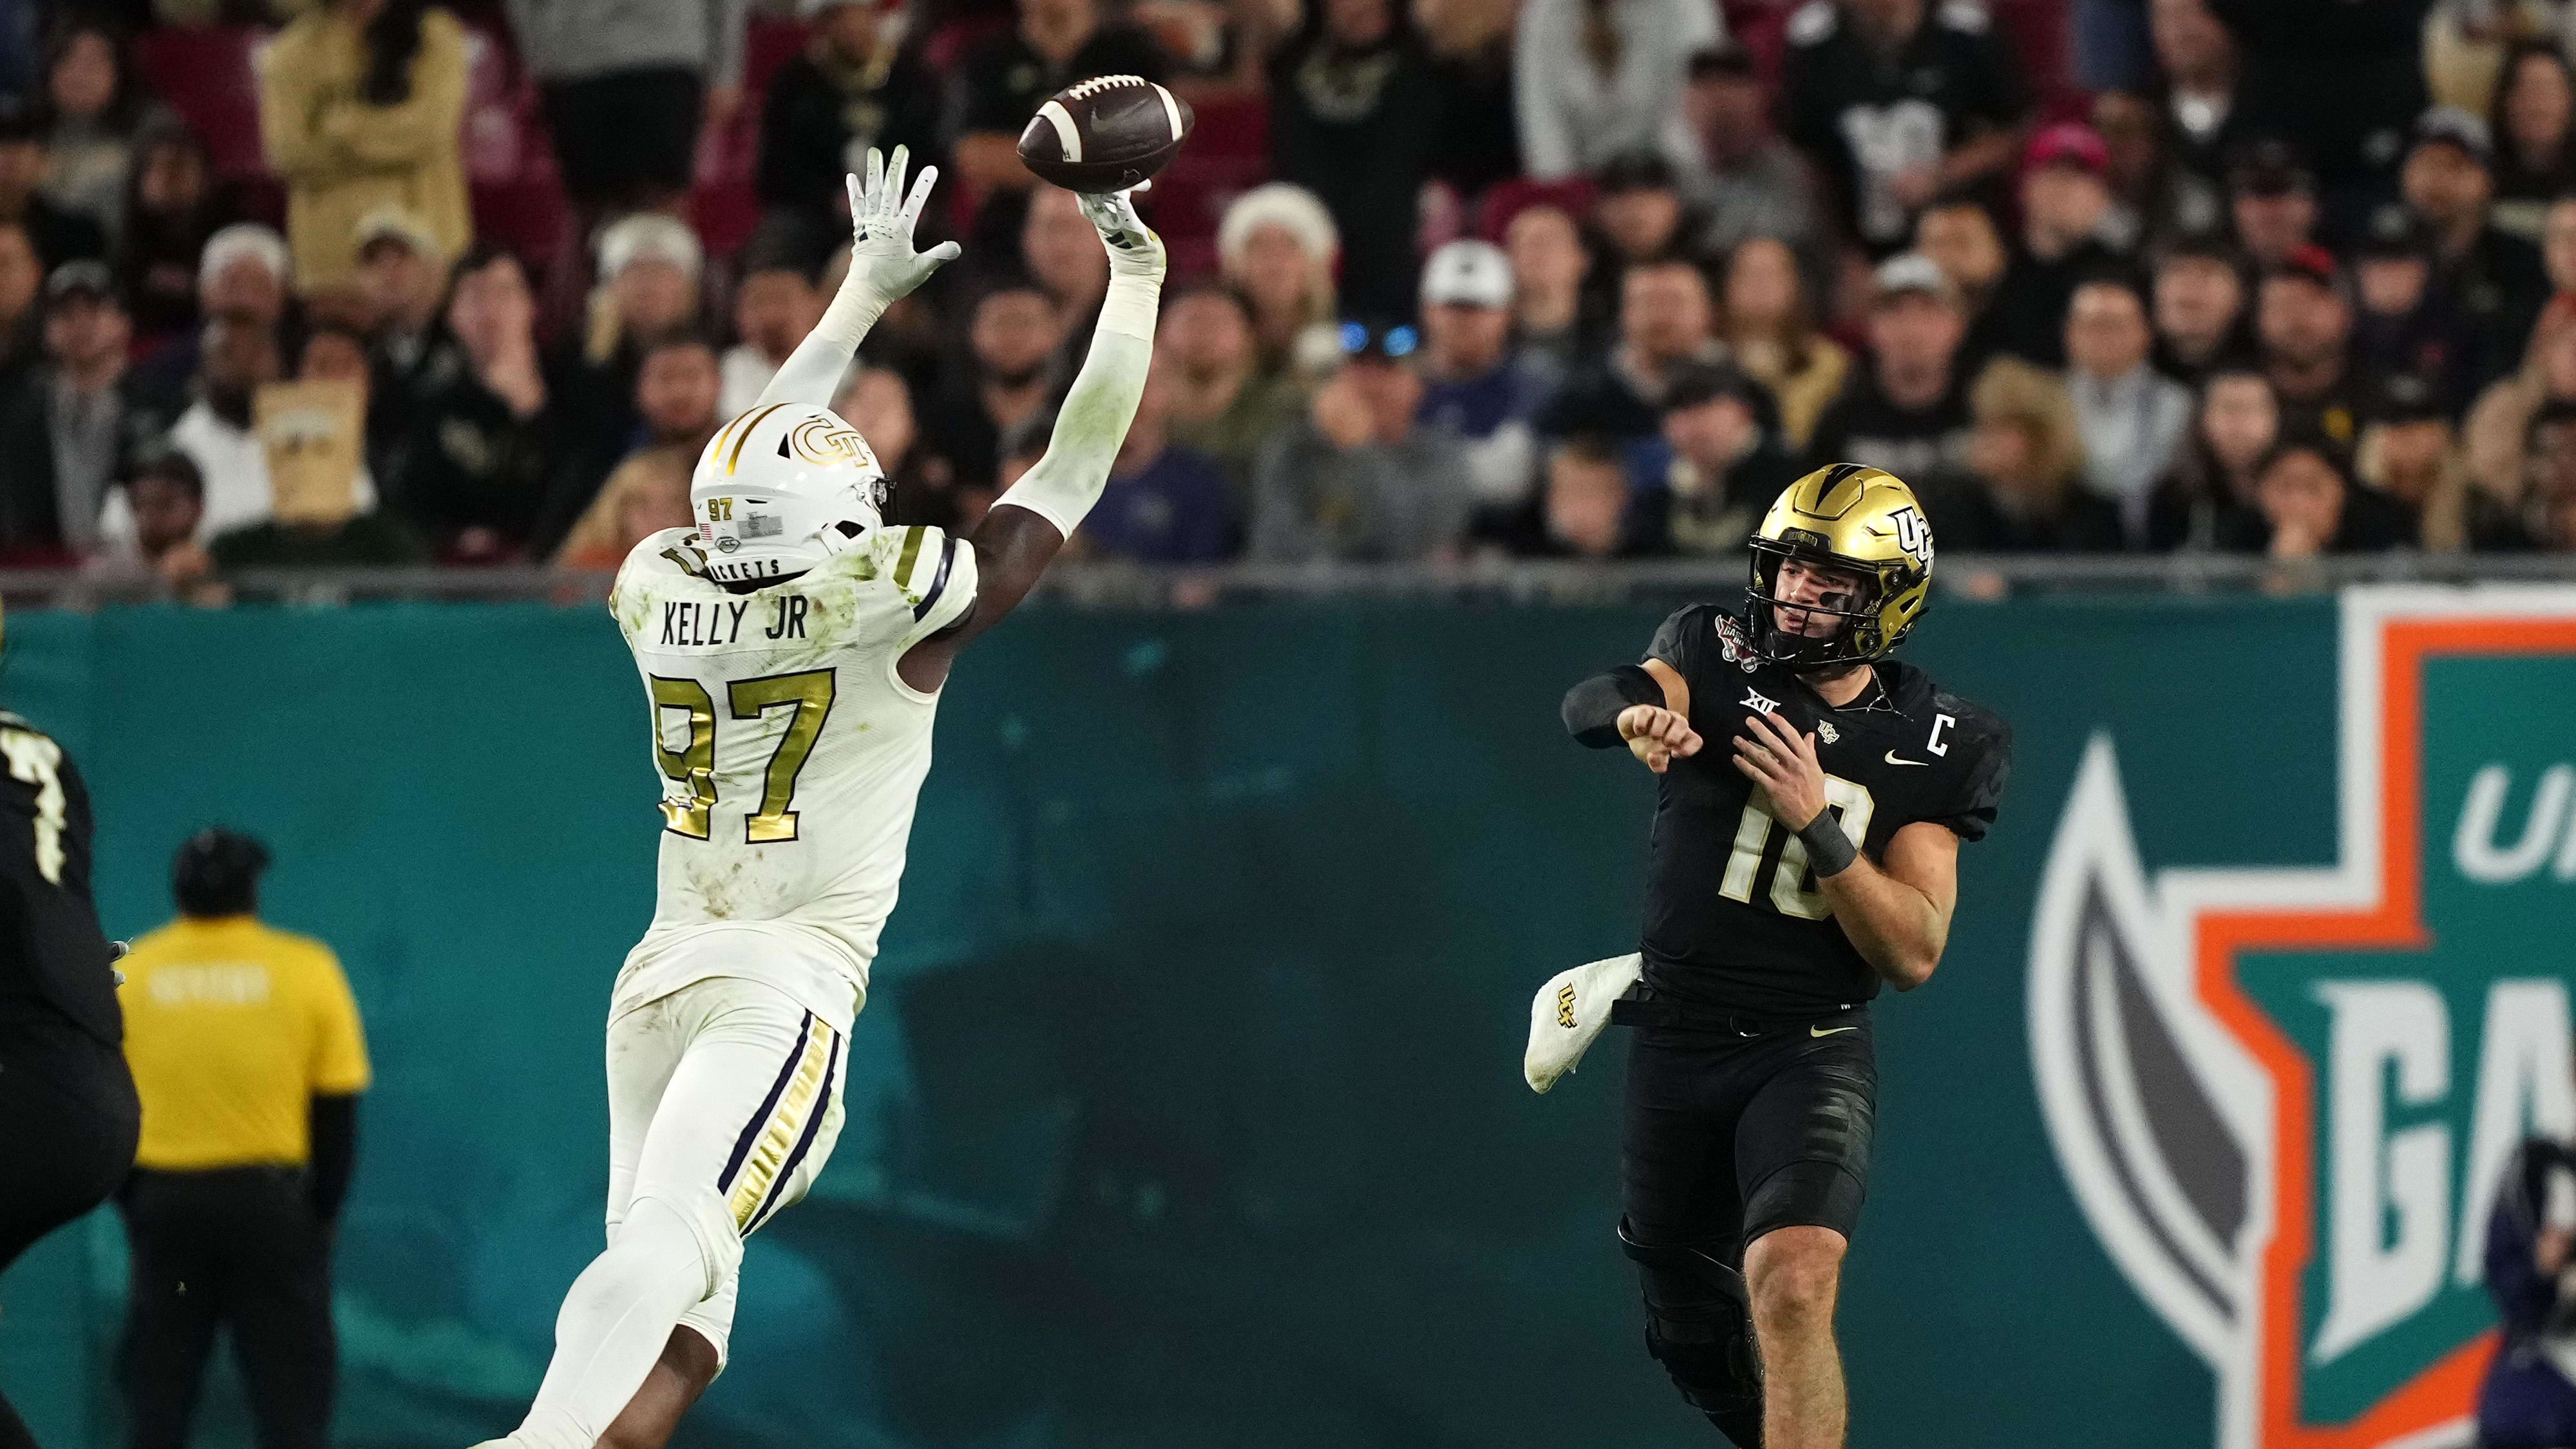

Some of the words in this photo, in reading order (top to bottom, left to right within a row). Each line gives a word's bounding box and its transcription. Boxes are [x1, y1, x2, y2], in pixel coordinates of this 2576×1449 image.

[793, 418, 868, 468] GT
[708, 497, 732, 522] 97
[661, 600, 748, 646] KELLY
[765, 595, 808, 639] JR
[1739, 685, 1781, 716] XII
[1817, 719, 1840, 744] UCF
[1927, 713, 1956, 757] C
[649, 667, 837, 845] 97
[2452, 762, 2576, 884] U
[1558, 981, 1578, 1029] UCF
